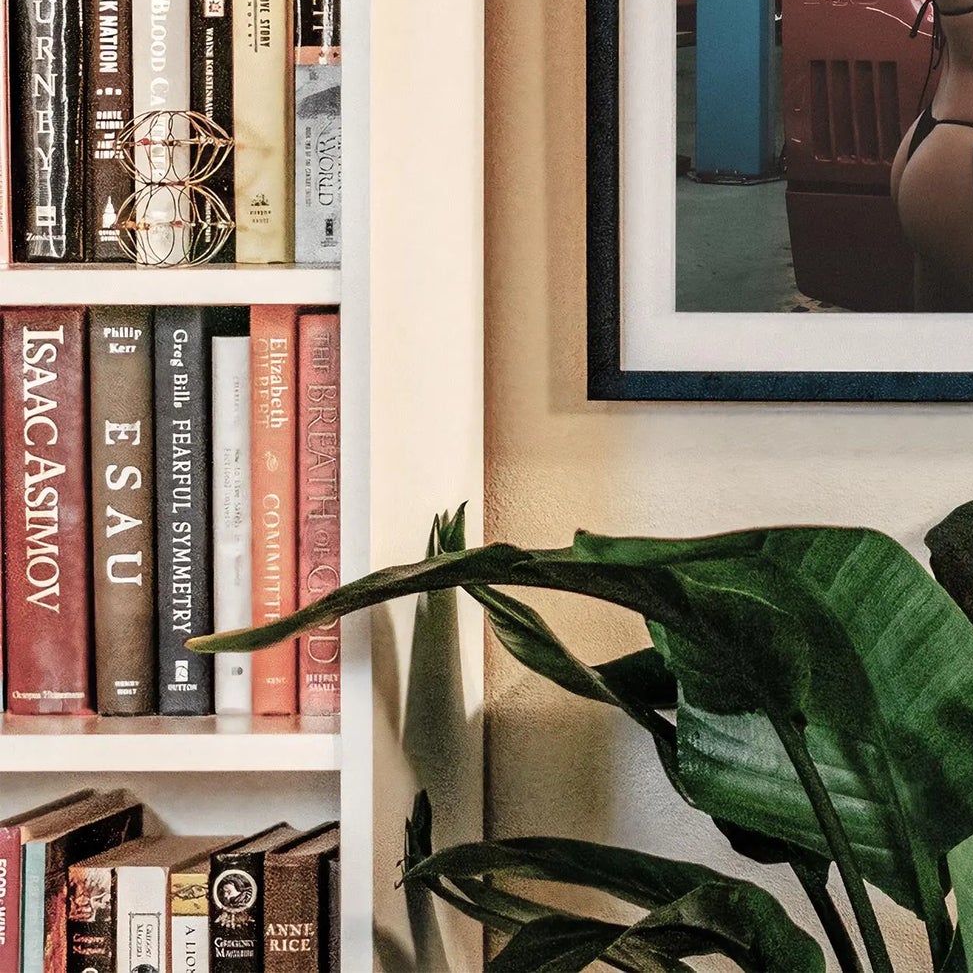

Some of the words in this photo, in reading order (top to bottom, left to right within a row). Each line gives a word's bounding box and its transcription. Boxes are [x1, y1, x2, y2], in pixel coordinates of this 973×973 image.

[99, 16, 118, 73] NATION
[260, 18, 270, 47] STORY
[319, 136, 336, 206] WORLD
[104, 327, 142, 339] Philip
[109, 343, 136, 354] Kerr
[171, 329, 188, 367] Greg
[312, 332, 330, 370] THE
[22, 325, 64, 446] ISAAC
[174, 374, 189, 408] Bills
[269, 337, 288, 428] Elizabeth
[172, 419, 191, 515] FEARFUL
[308, 384, 338, 520] BREATH
[105, 420, 142, 586] ESAU
[24, 450, 66, 614] ASIMOV
[172, 521, 191, 634] SYMMETRY
[168, 683, 197, 691] DUTTON
[186, 926, 195, 935] A
[266, 923, 315, 937] ANNE
[270, 938, 311, 952] RICE
